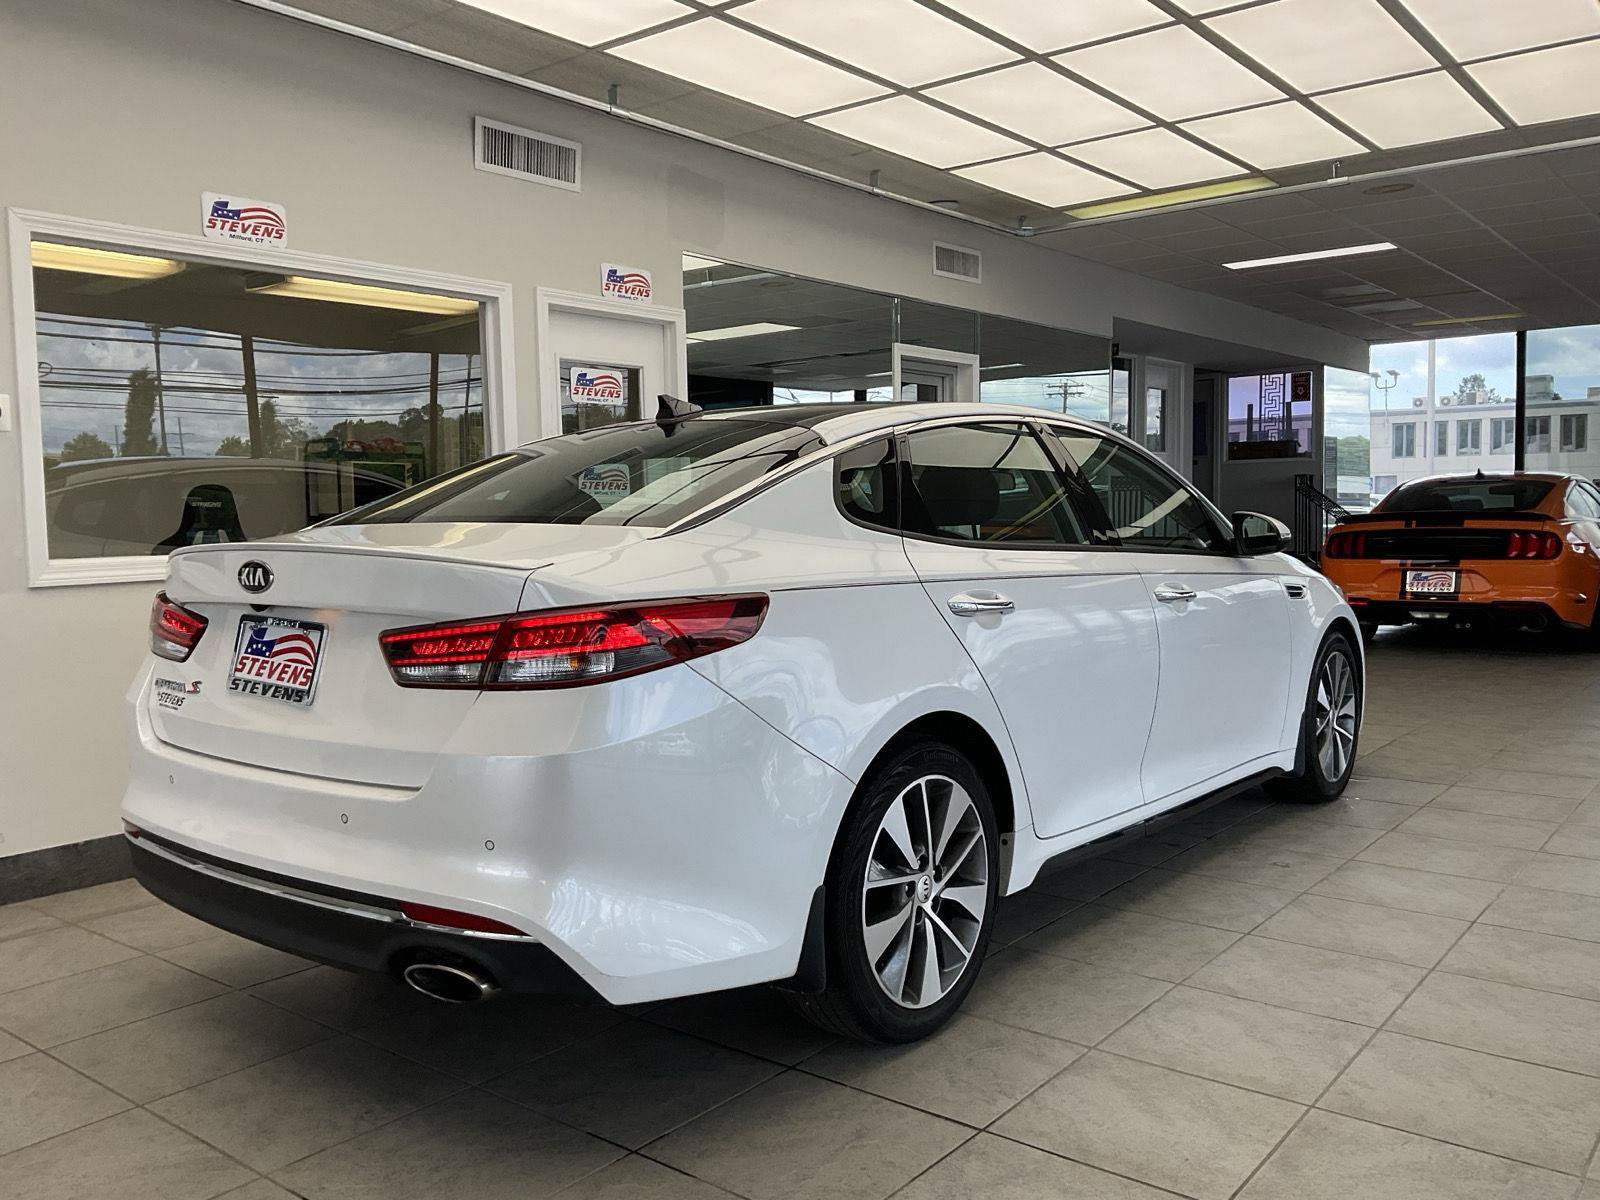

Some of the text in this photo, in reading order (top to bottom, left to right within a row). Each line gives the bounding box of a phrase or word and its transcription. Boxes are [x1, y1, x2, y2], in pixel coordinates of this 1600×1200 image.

[206, 217, 285, 240] STEVENS
[229, 233, 253, 242] Milford,
[604, 282, 651, 298] STEVENS
[573, 386, 622, 399] STEVENS
[580, 481, 629, 491] STEVENS
[241, 567, 266, 587] KIA
[234, 656, 314, 687] STEVENS
[229, 678, 307, 703] STEVENS
[158, 692, 185, 707] STEVENS
